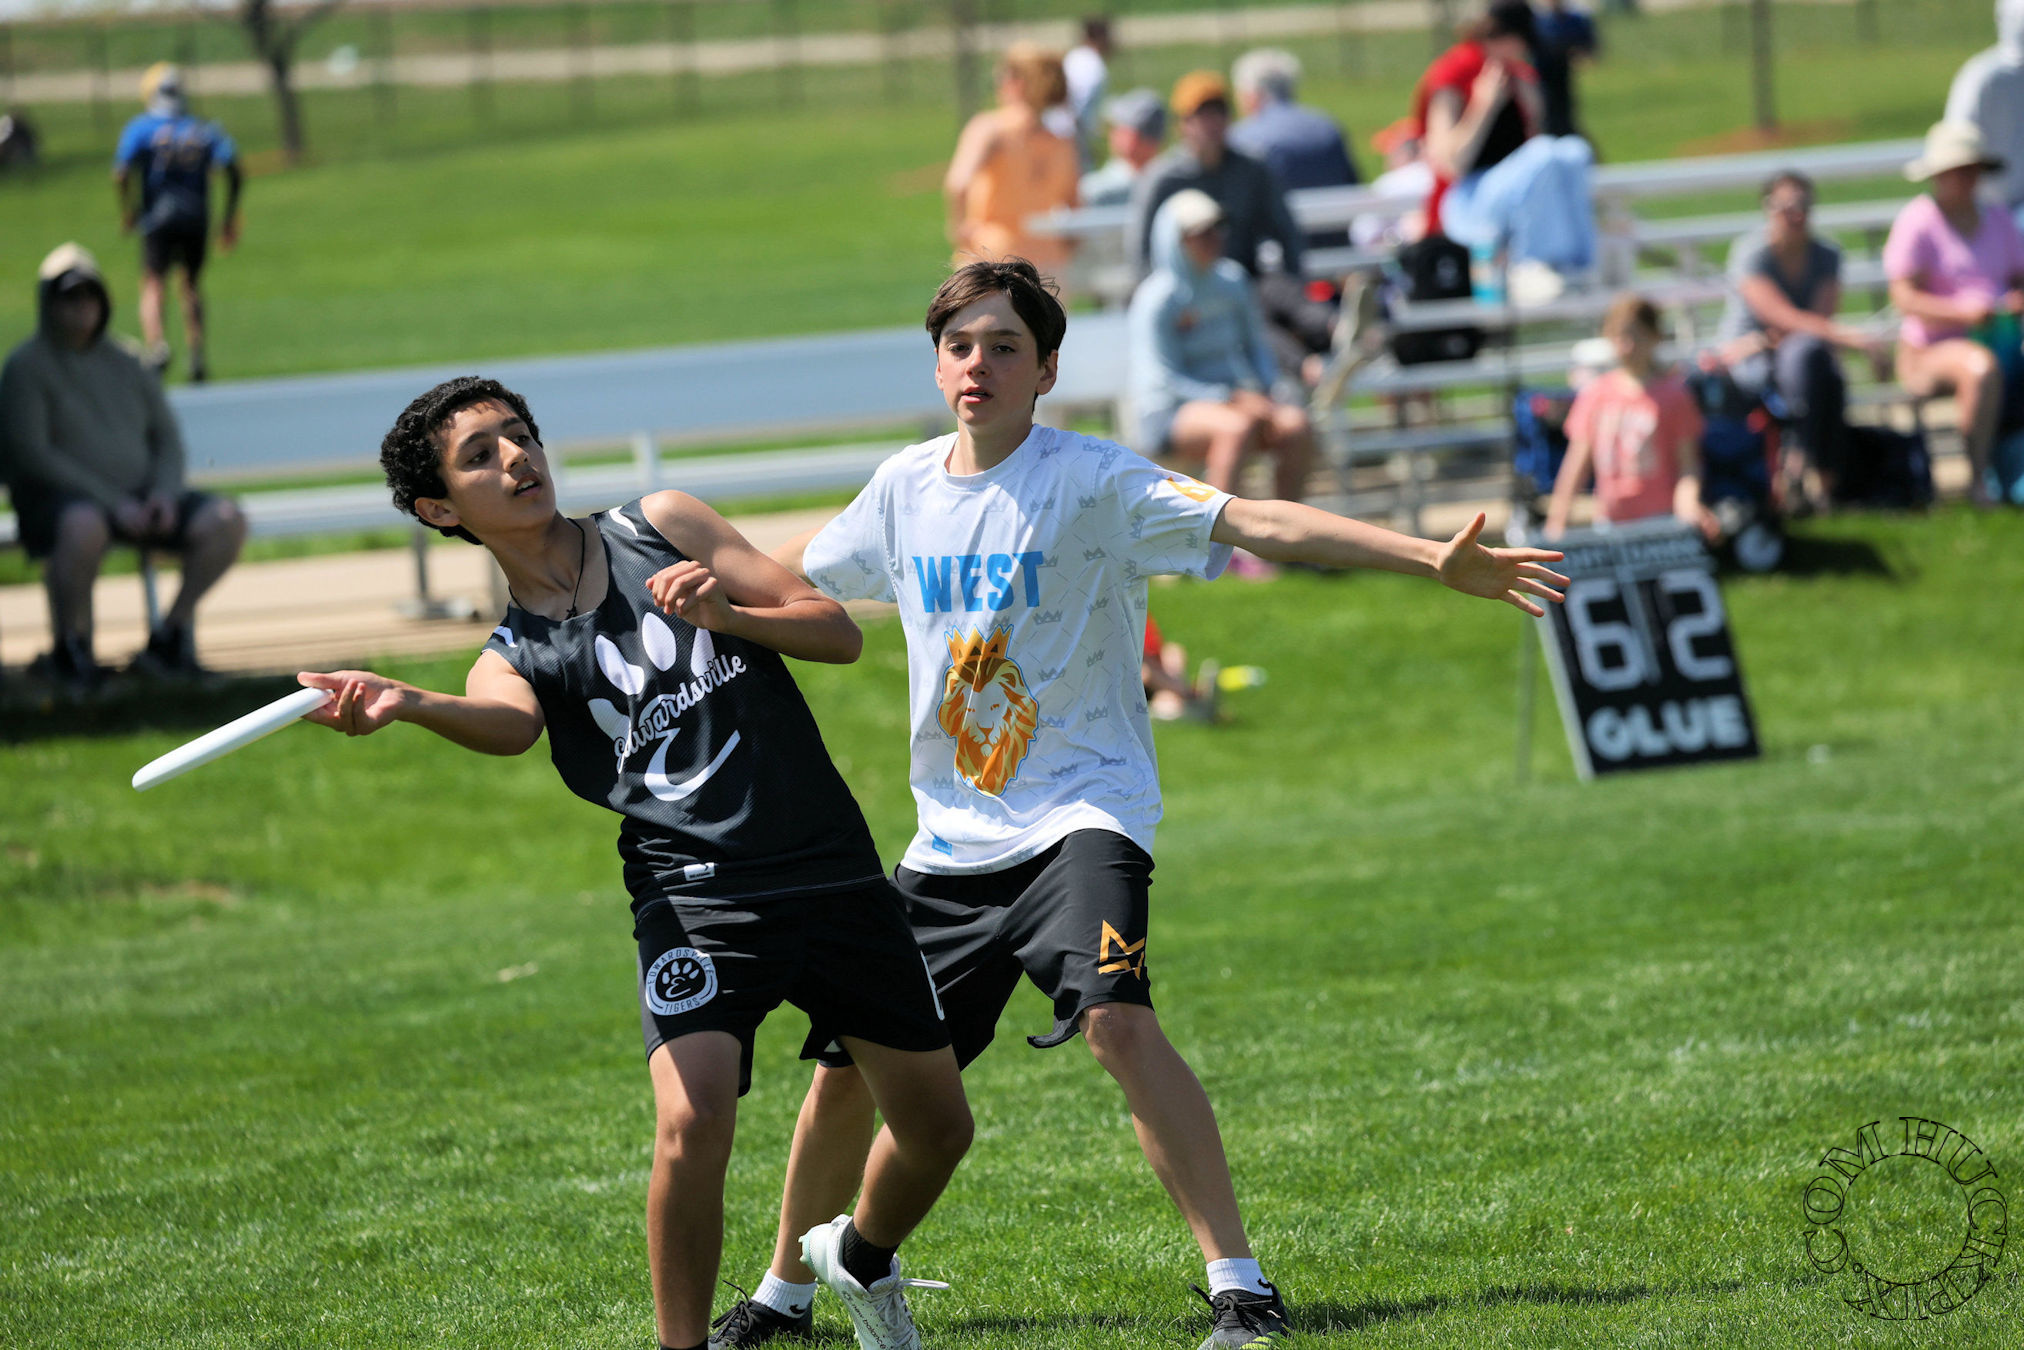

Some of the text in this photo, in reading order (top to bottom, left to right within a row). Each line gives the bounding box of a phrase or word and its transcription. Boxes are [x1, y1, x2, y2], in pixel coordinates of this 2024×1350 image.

[911, 550, 1044, 613] WEST
[1565, 567, 1733, 692] 6 2
[1585, 694, 1750, 761] GLUE
[664, 997, 700, 1014] TIGERS
[863, 1319, 887, 1349] balance
